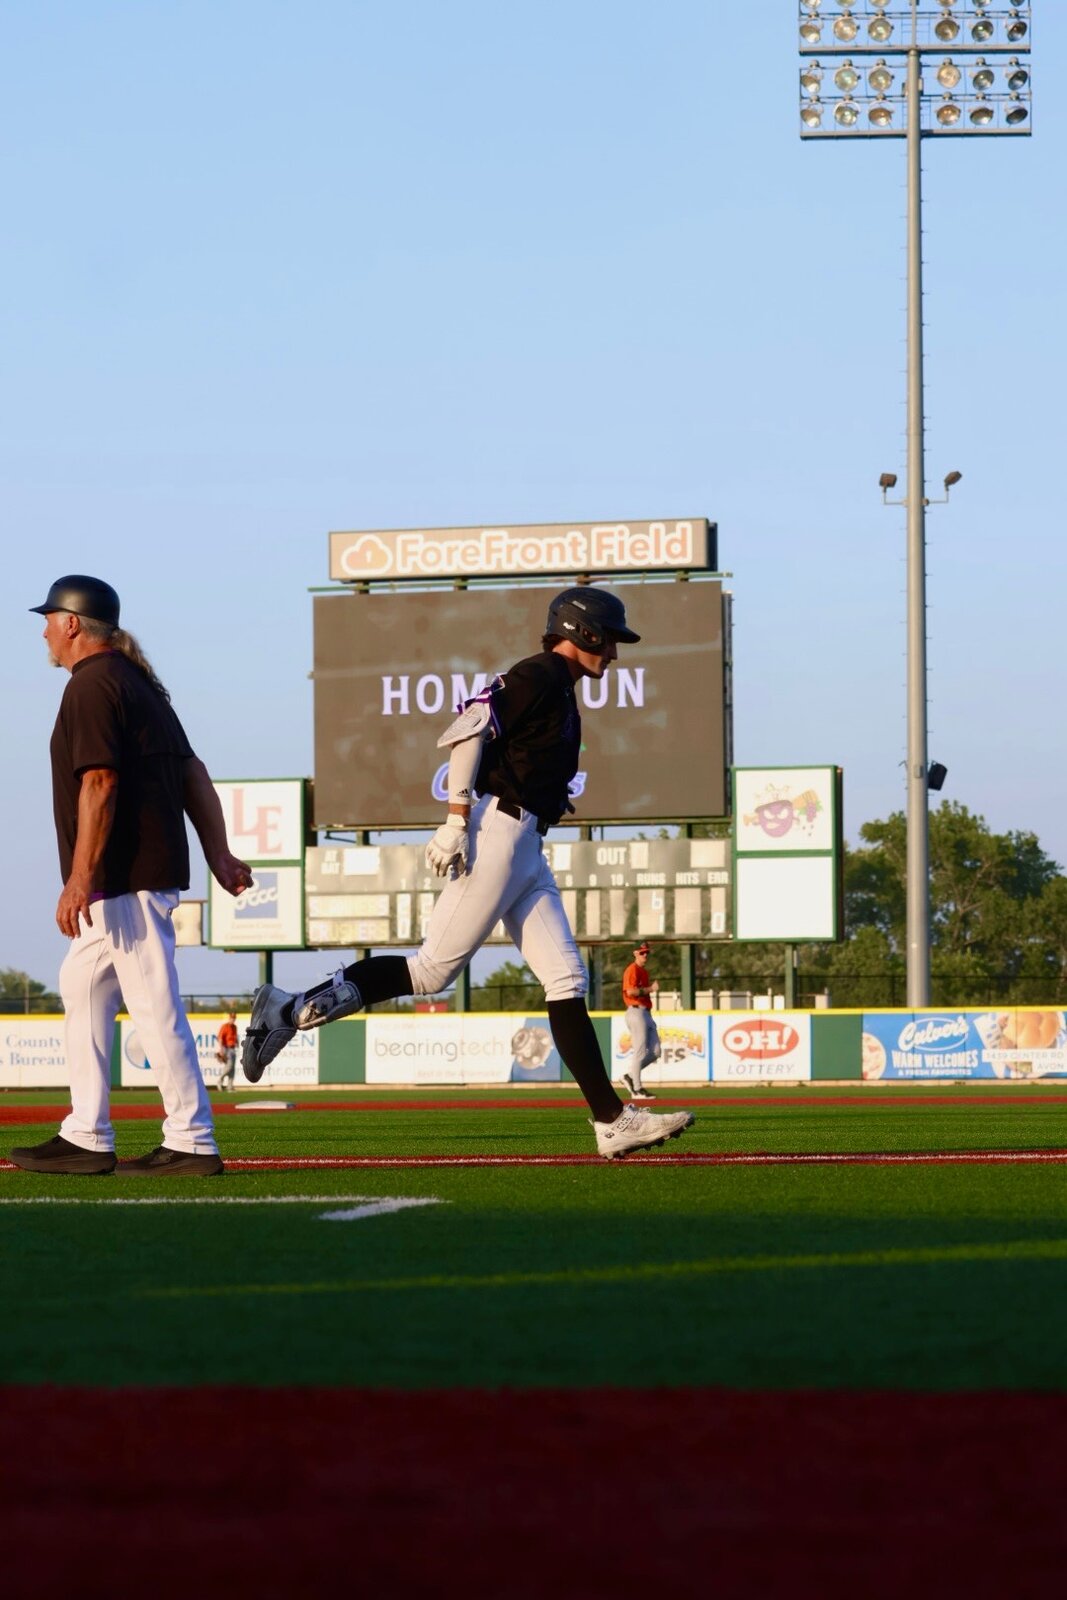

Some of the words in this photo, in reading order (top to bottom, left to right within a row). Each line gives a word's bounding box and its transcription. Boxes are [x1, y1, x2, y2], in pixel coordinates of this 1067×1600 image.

[397, 530, 587, 573] ForeFront
[591, 522, 692, 566] Field
[381, 673, 488, 715] HOM
[582, 668, 646, 709] UN
[597, 847, 626, 865] OUT
[636, 872, 666, 886] RUNS
[675, 871, 699, 885] HITS
[707, 871, 729, 885] ERR
[6, 1033, 62, 1053] County
[725, 1026, 793, 1052] OH!
[10, 1051, 66, 1066] Bureau
[374, 1036, 504, 1062] bearingtech
[891, 1050, 922, 1068] WARM
[924, 1049, 978, 1068] WELCOMES
[727, 1064, 794, 1075] LOTTERY
[1037, 1063, 1065, 1071] AVON
